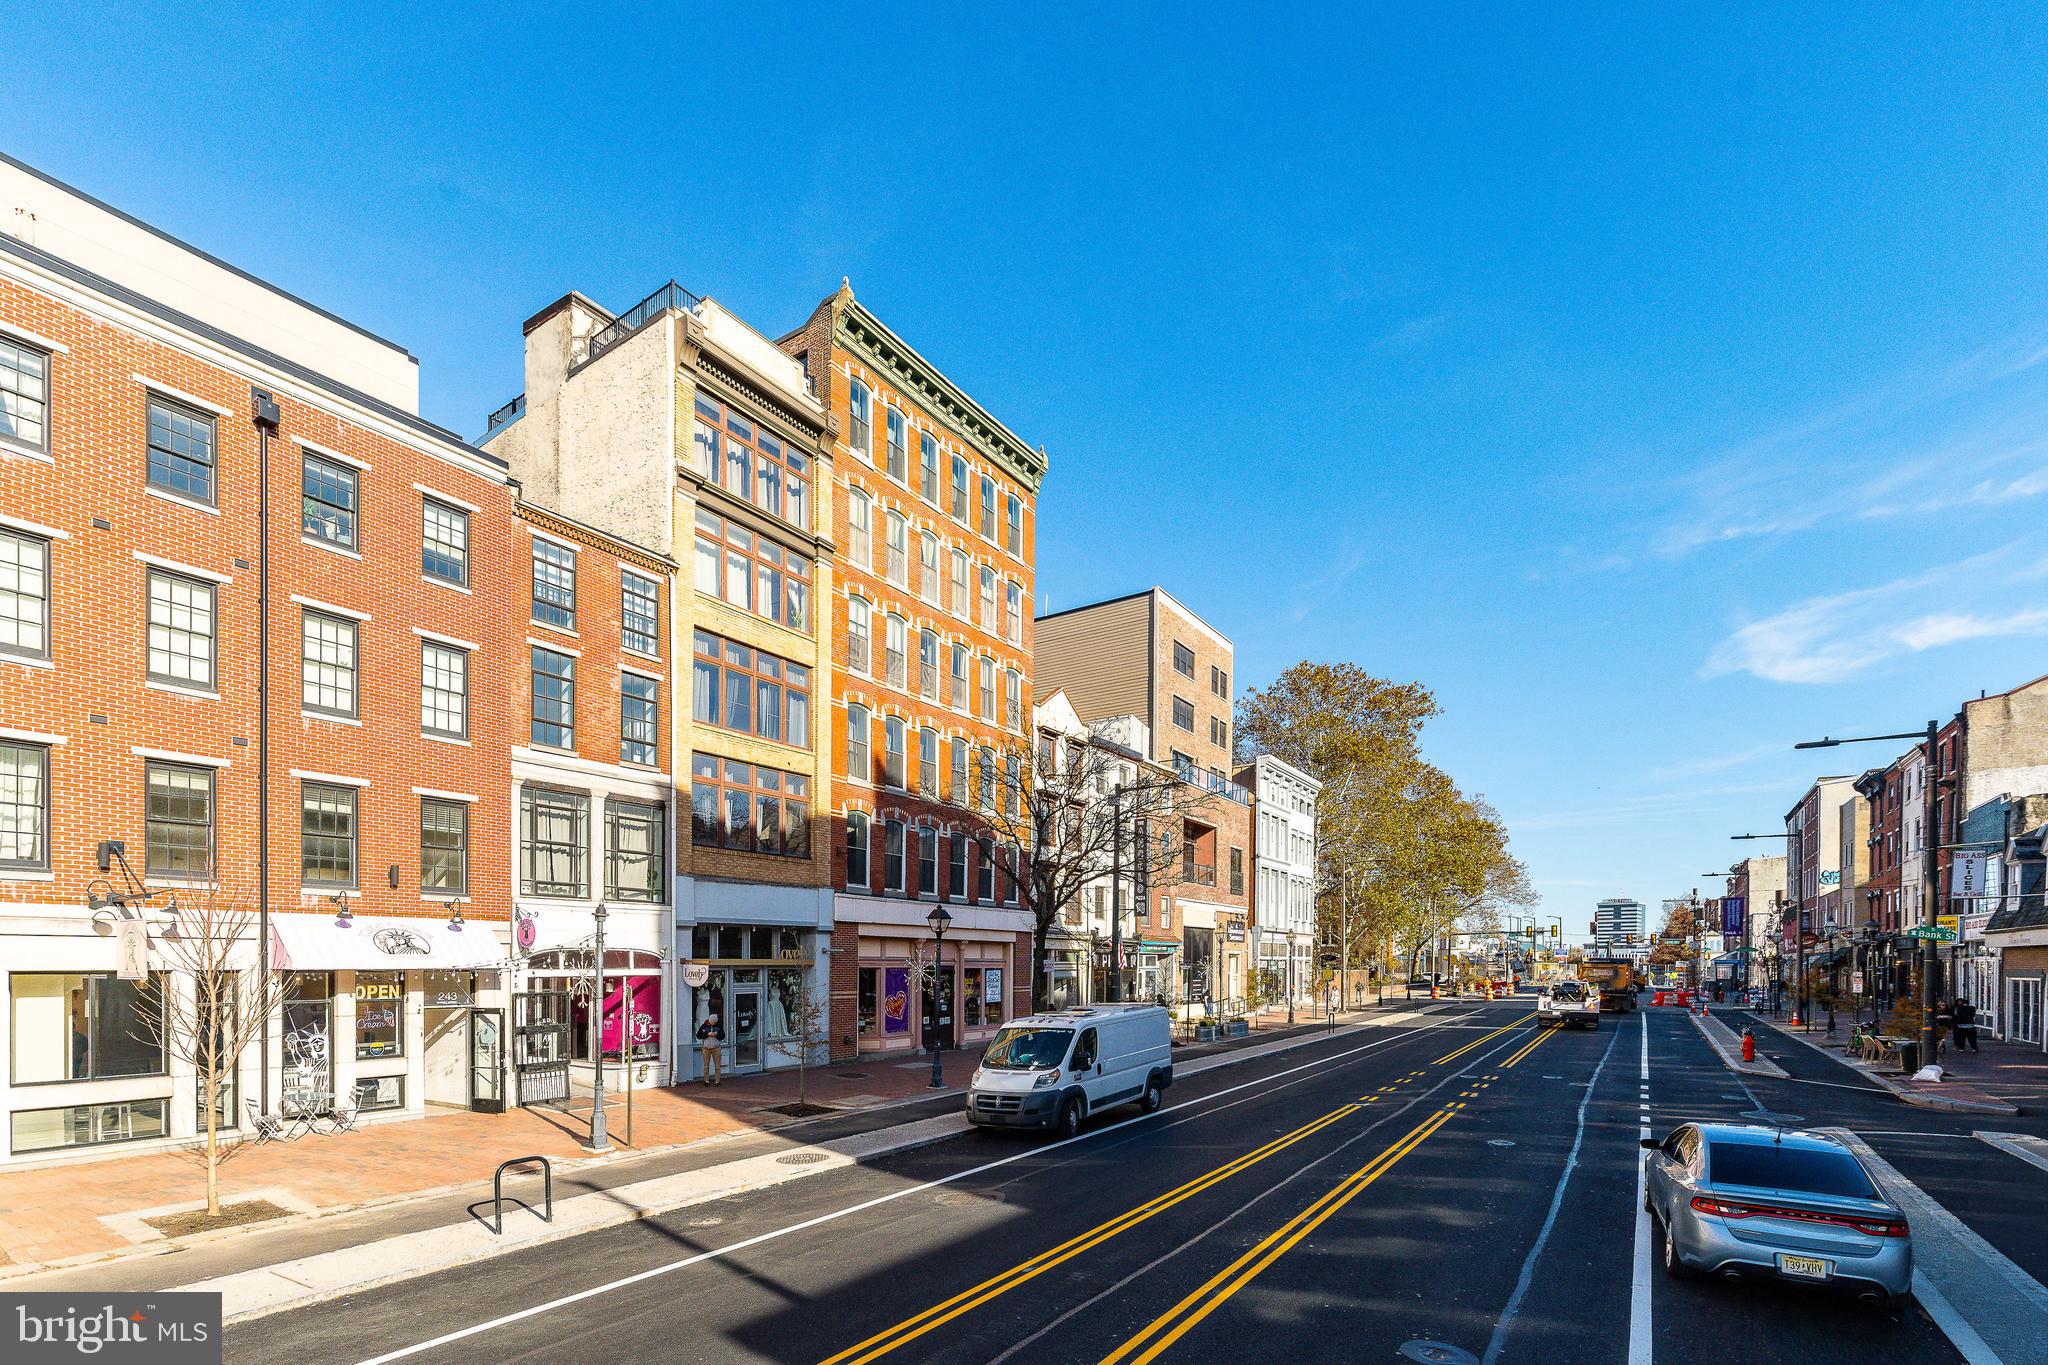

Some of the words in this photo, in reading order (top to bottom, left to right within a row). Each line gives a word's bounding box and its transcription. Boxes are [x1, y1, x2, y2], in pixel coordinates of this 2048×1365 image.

[1964, 859, 1974, 891] SLICES
[1918, 930, 1942, 939] Bank
[1945, 932, 1955, 940] St
[684, 967, 707, 981] Lovely
[355, 984, 400, 1000] OPEN
[438, 991, 458, 1001] 243
[364, 1008, 382, 1020] Ice
[356, 1018, 387, 1029] Cream
[1784, 1260, 1800, 1270] T39
